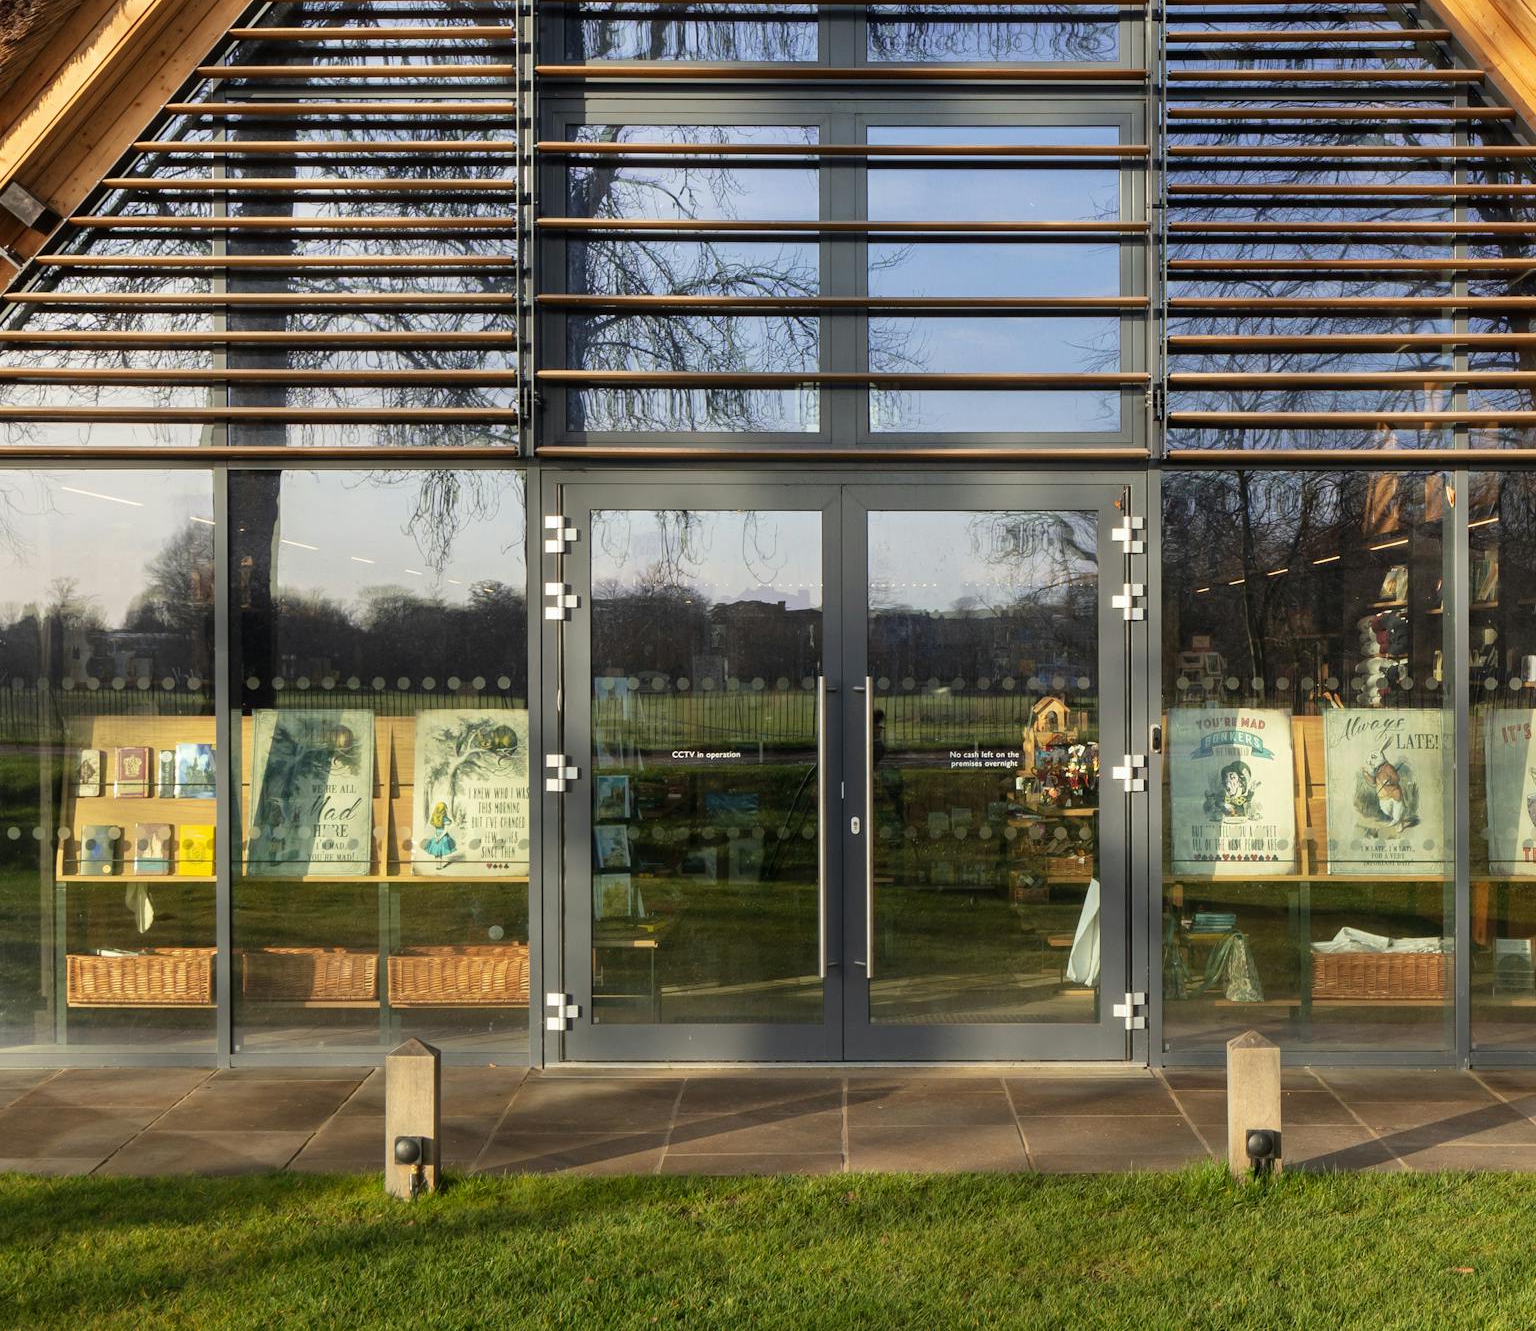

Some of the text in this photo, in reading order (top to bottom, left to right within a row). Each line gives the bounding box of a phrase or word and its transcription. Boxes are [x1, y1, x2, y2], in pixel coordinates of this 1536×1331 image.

[1240, 717, 1265, 729] MAD
[1502, 722, 1531, 743] IT'S
[1205, 731, 1260, 750] BONKERS
[1396, 733, 1439, 750] LATE!
[672, 750, 741, 760] CCTV in operation
[963, 750, 979, 758] cash
[981, 750, 993, 758] left
[1007, 750, 1020, 758] the
[951, 760, 1018, 769] premises overnight
[340, 784, 357, 794] ALL
[473, 787, 490, 799] KNEW
[494, 787, 508, 799] WHO
[478, 801, 519, 814] THIS MORNING
[500, 816, 525, 829] CHANGED
[481, 845, 516, 859] SINCE THEN
